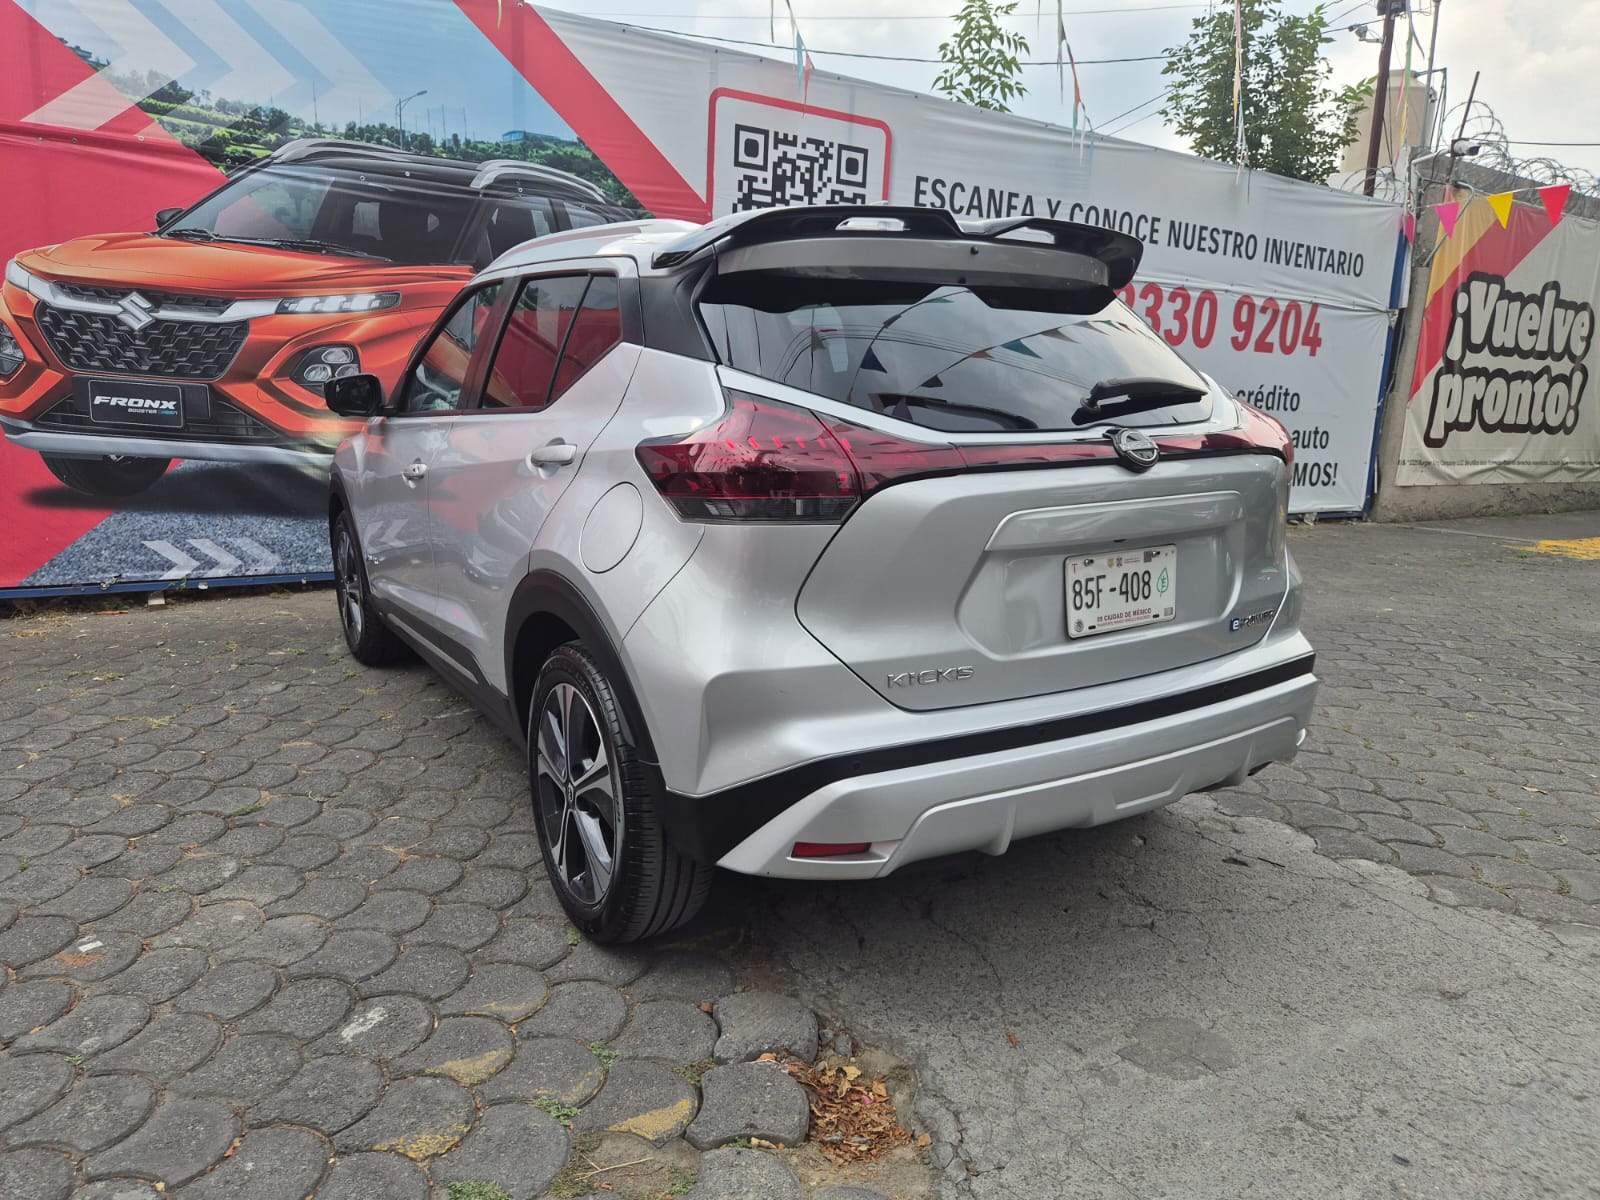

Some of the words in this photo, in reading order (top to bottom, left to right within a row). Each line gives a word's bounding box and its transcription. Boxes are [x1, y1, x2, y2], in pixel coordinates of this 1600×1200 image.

[1046, 198, 1062, 219] Y
[1069, 202, 1161, 245] CONOCE
[1167, 219, 1258, 261] NUESTRO
[1263, 237, 1365, 278] INVENTARIO
[1230, 294, 1323, 357] 9204
[1444, 275, 1593, 364] ¡Vuelve
[93, 395, 177, 410] FRONX
[1426, 367, 1587, 443] pronto!
[1291, 426, 1330, 450] auto
[1072, 569, 1152, 611] 85F-408
[887, 665, 974, 689] KICKS
